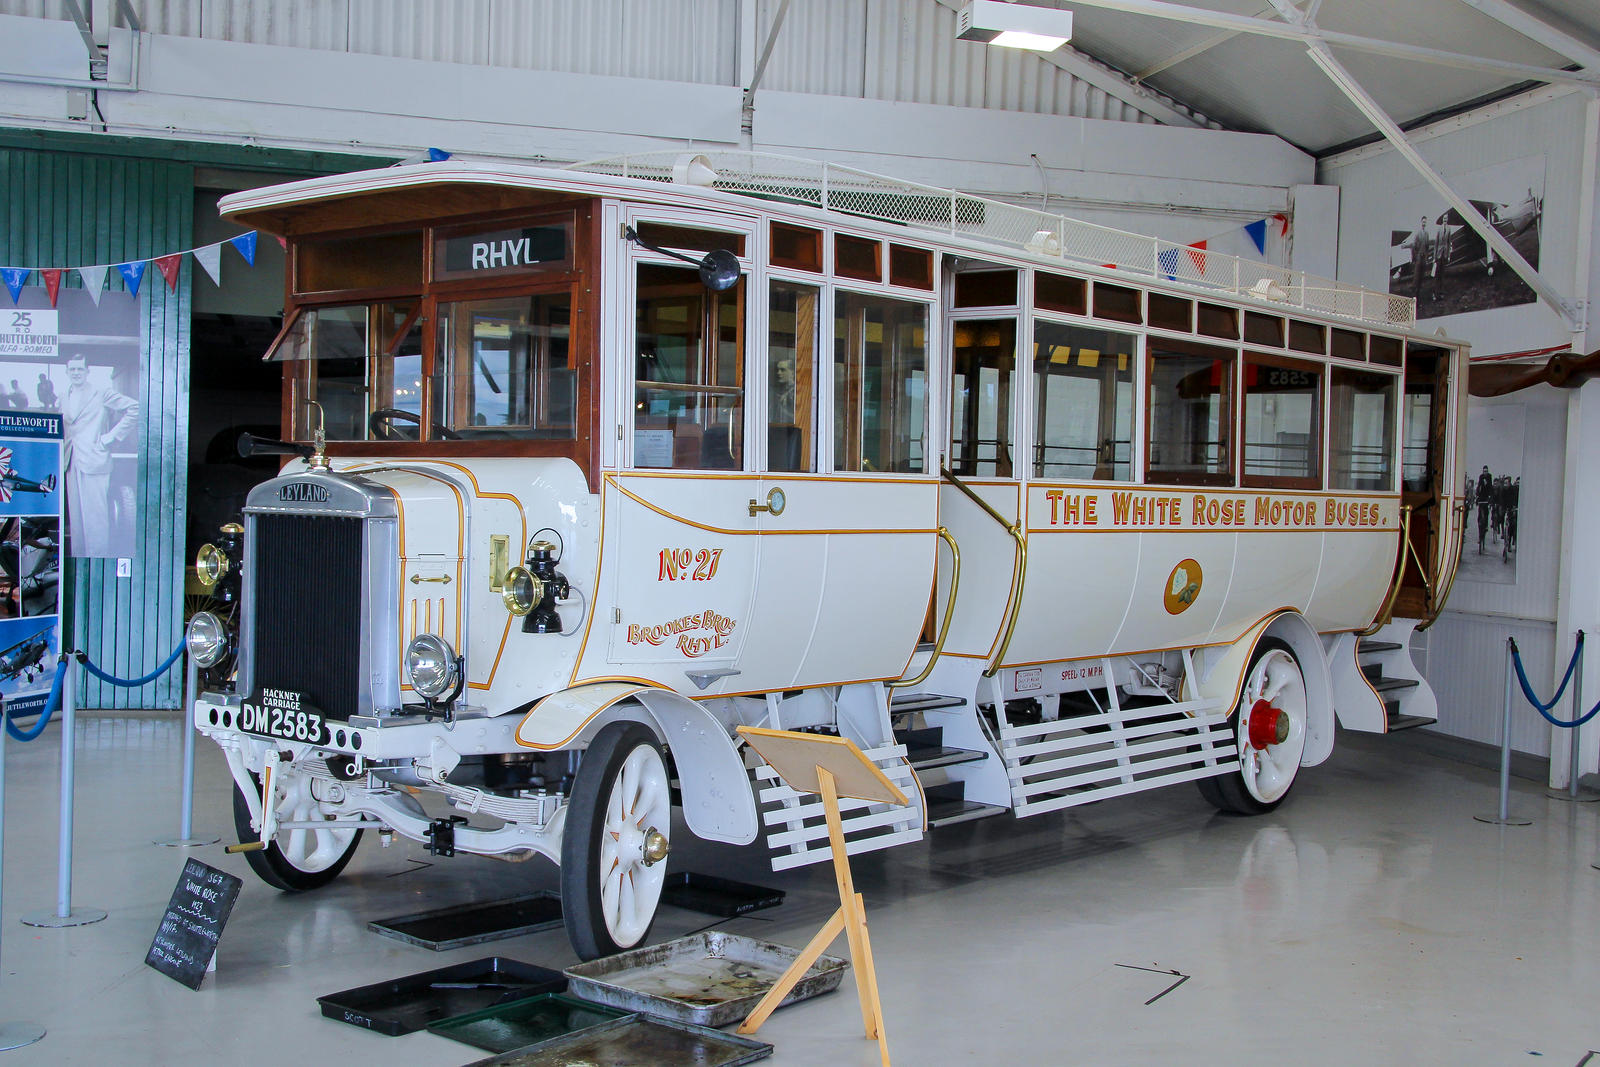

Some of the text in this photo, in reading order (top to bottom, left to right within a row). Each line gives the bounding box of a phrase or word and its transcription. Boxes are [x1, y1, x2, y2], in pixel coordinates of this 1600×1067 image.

[472, 238, 540, 270] RHYL
[10, 311, 32, 327] 25
[280, 483, 327, 502] LEYLAND
[1046, 490, 1387, 527] THE WHITE ROSE MOTOR BUSES.
[120, 562, 127, 574] 1
[692, 548, 724, 581] 27
[627, 613, 702, 647] BROOKES
[263, 687, 301, 702] HACKNEY
[263, 696, 301, 711] CARRIAGE
[243, 703, 322, 742] DM 2583
